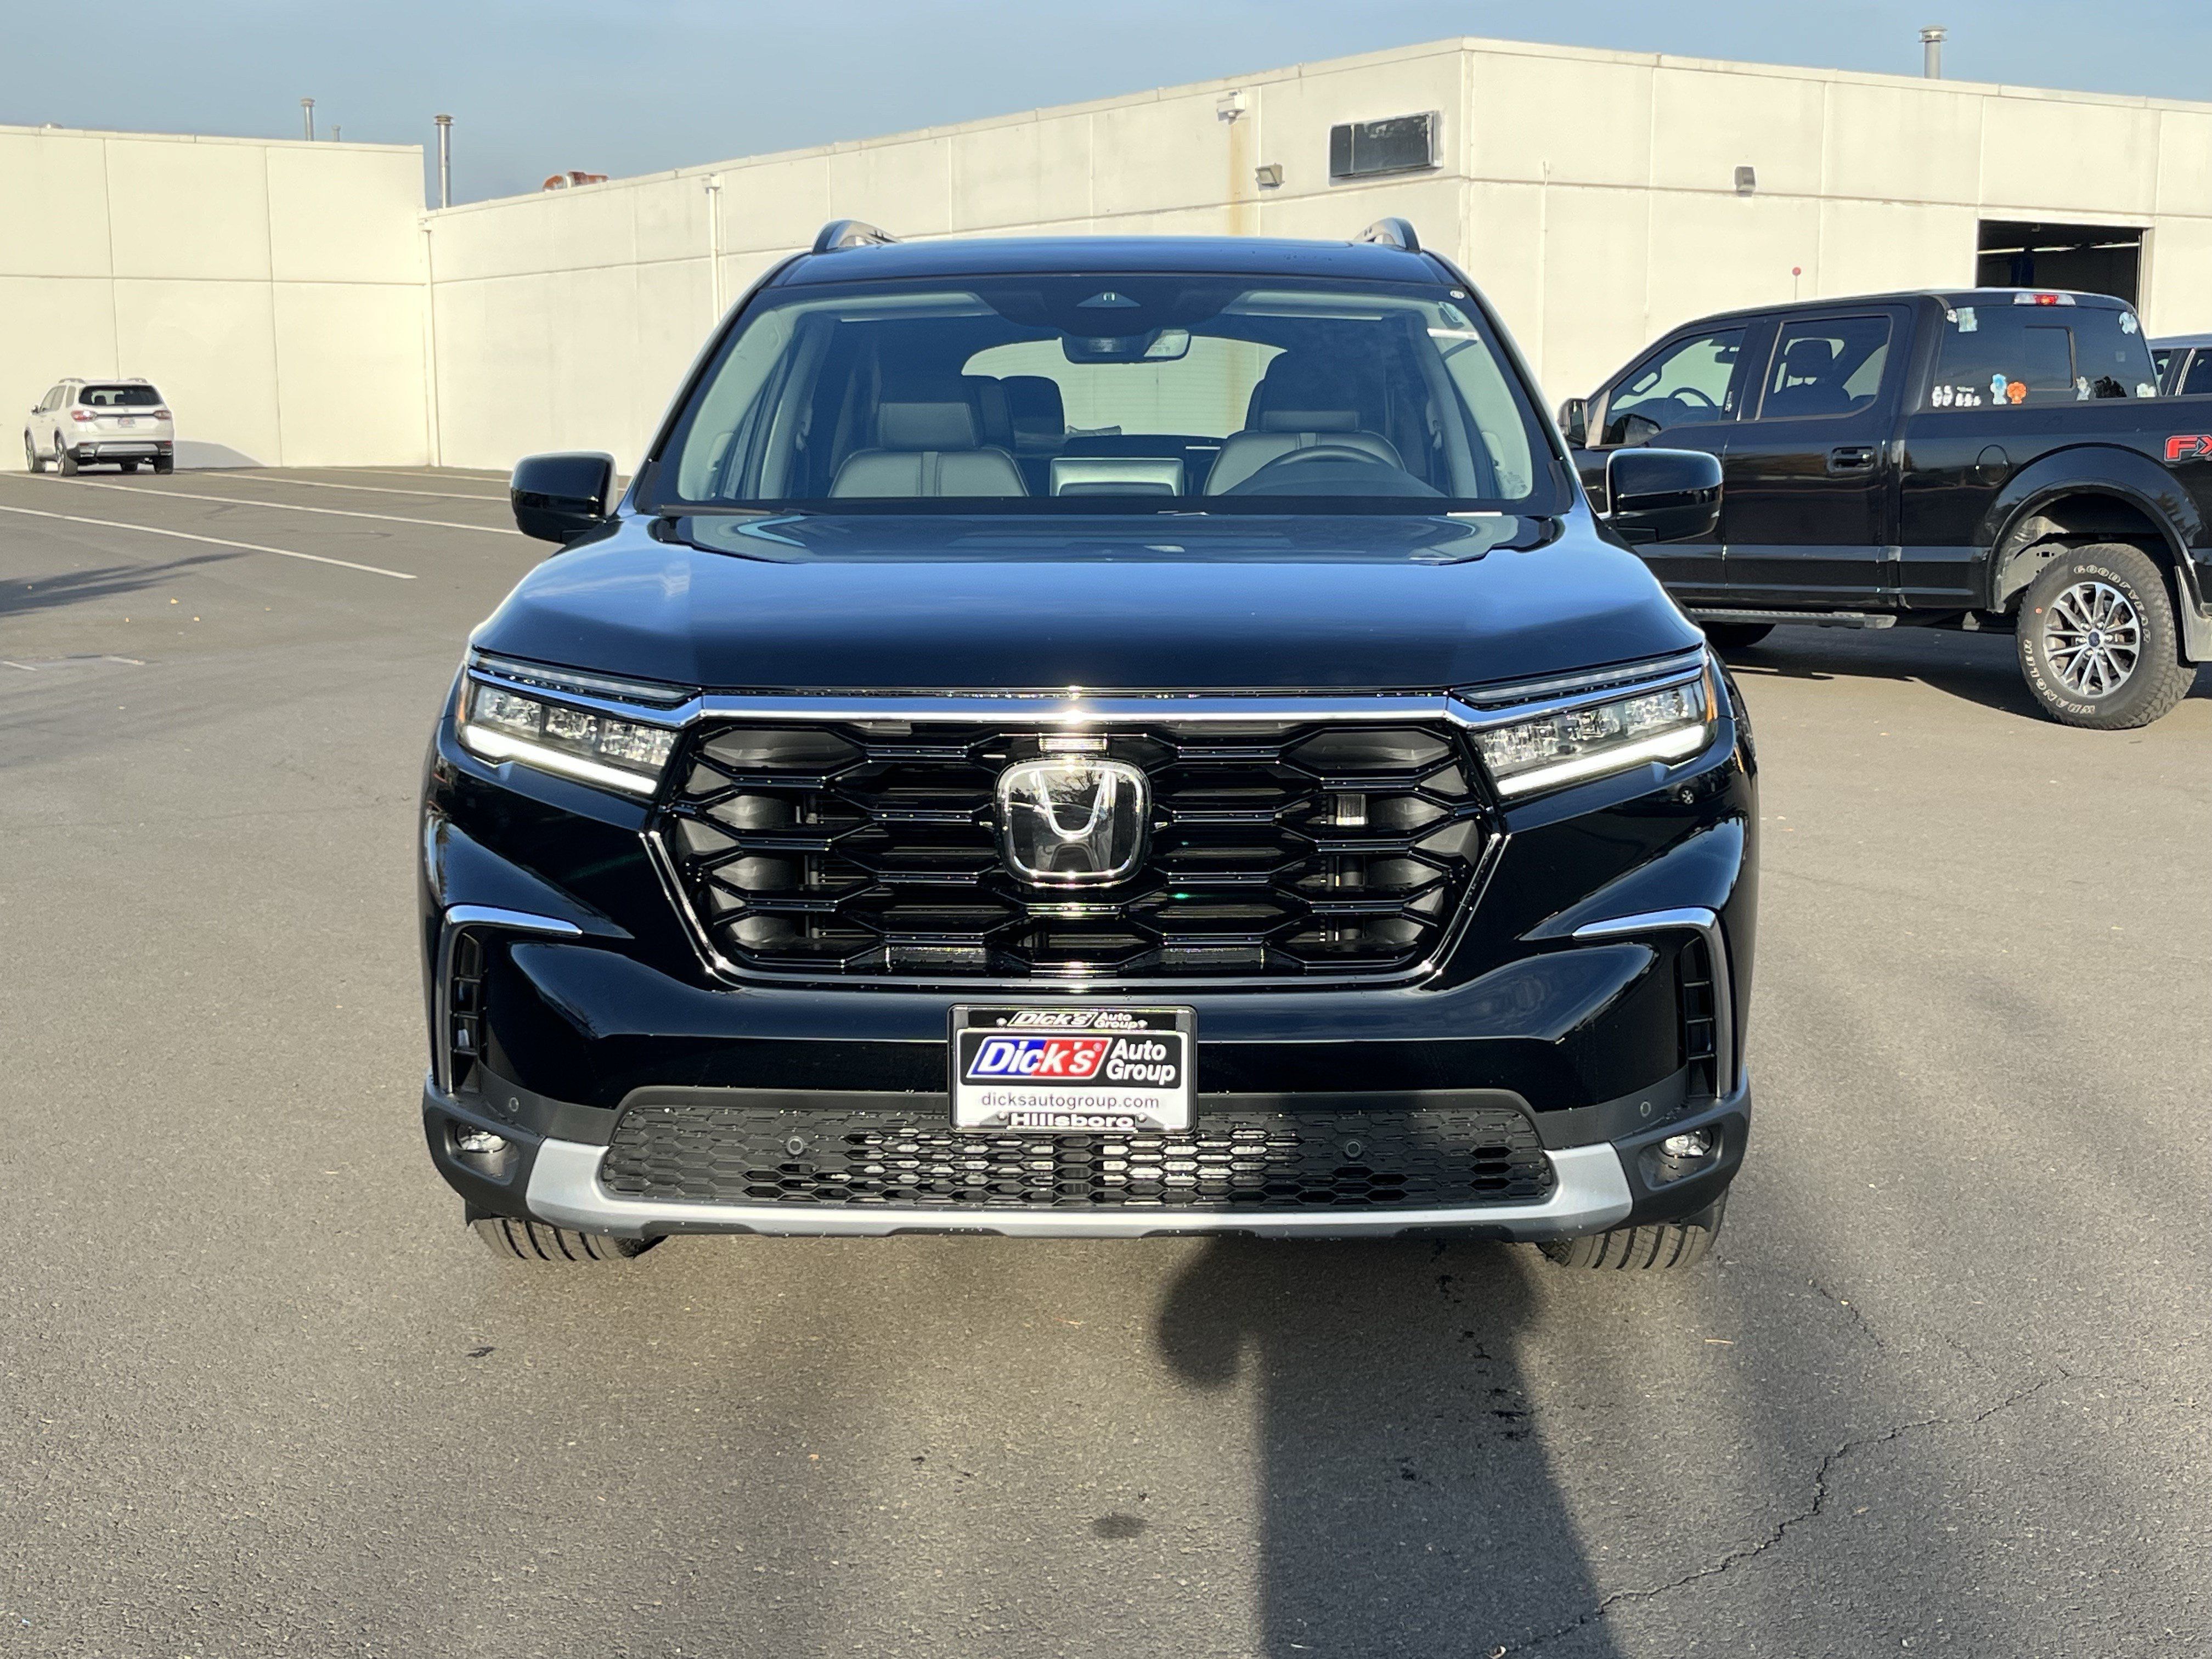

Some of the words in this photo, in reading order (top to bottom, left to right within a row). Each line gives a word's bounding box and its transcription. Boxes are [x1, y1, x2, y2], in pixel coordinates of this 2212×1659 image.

[1093, 1019, 1138, 1029] Group
[1097, 1012, 1132, 1021] Auto
[977, 1041, 1096, 1073] Dick's
[1109, 1038, 1167, 1060] Auto
[1106, 1058, 1176, 1085] Group
[981, 1092, 1160, 1110] dicksautogroup.com
[1011, 1113, 1135, 1127] Hillsboro
